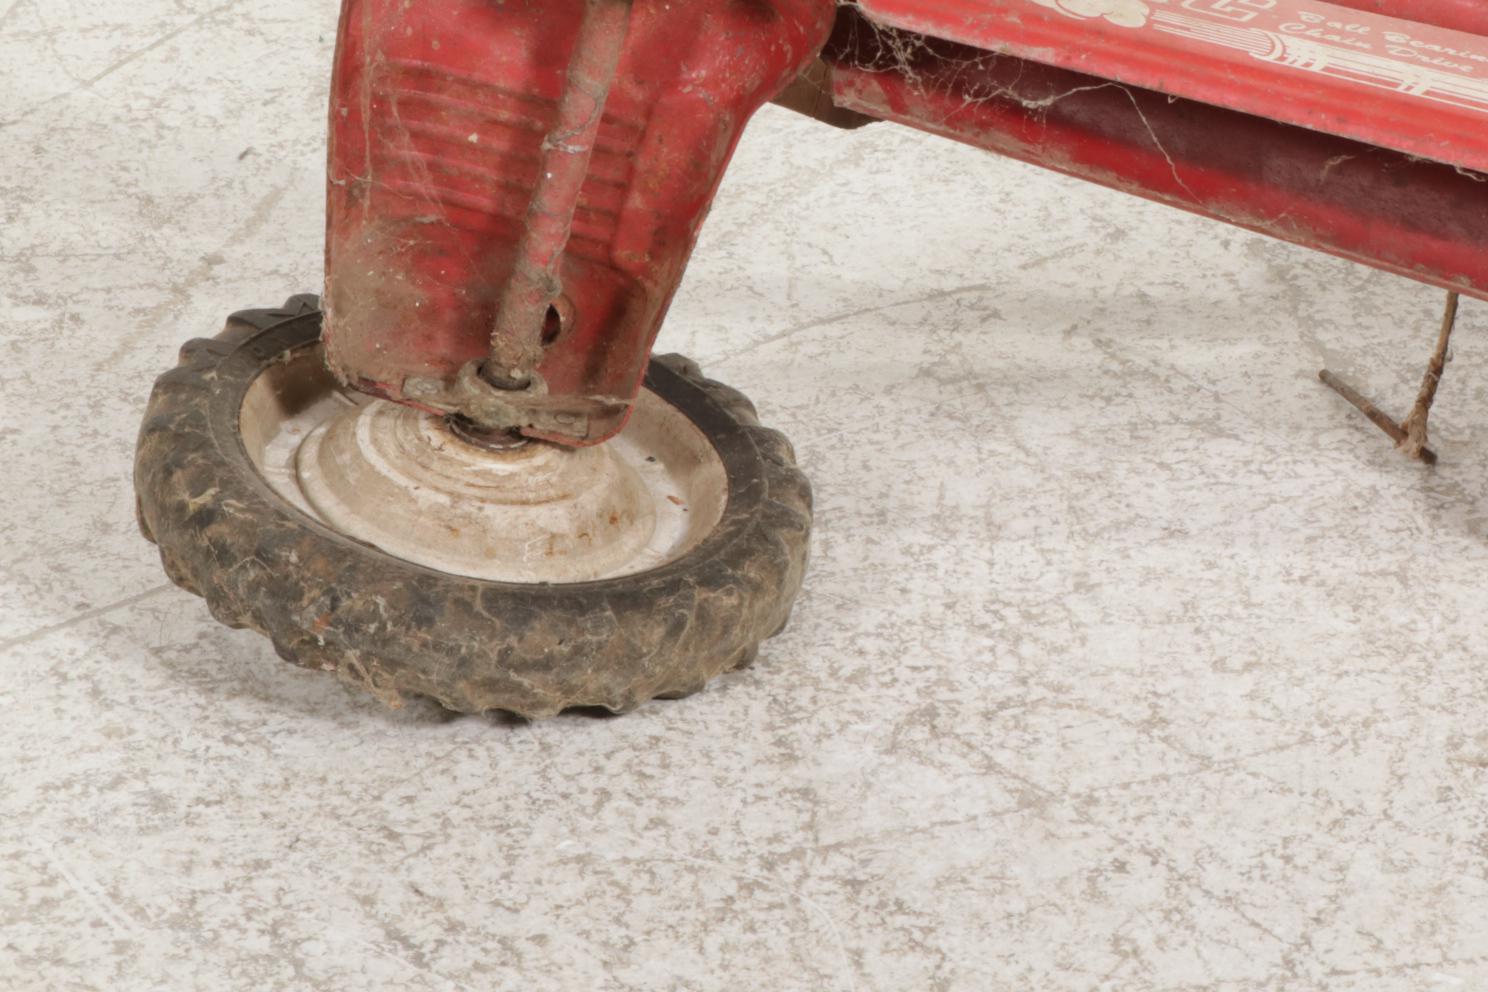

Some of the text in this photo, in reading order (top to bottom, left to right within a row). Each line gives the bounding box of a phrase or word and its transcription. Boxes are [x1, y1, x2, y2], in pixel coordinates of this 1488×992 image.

[1298, 11, 1371, 35] Ball
[1279, 22, 1473, 73] Chain Drive
